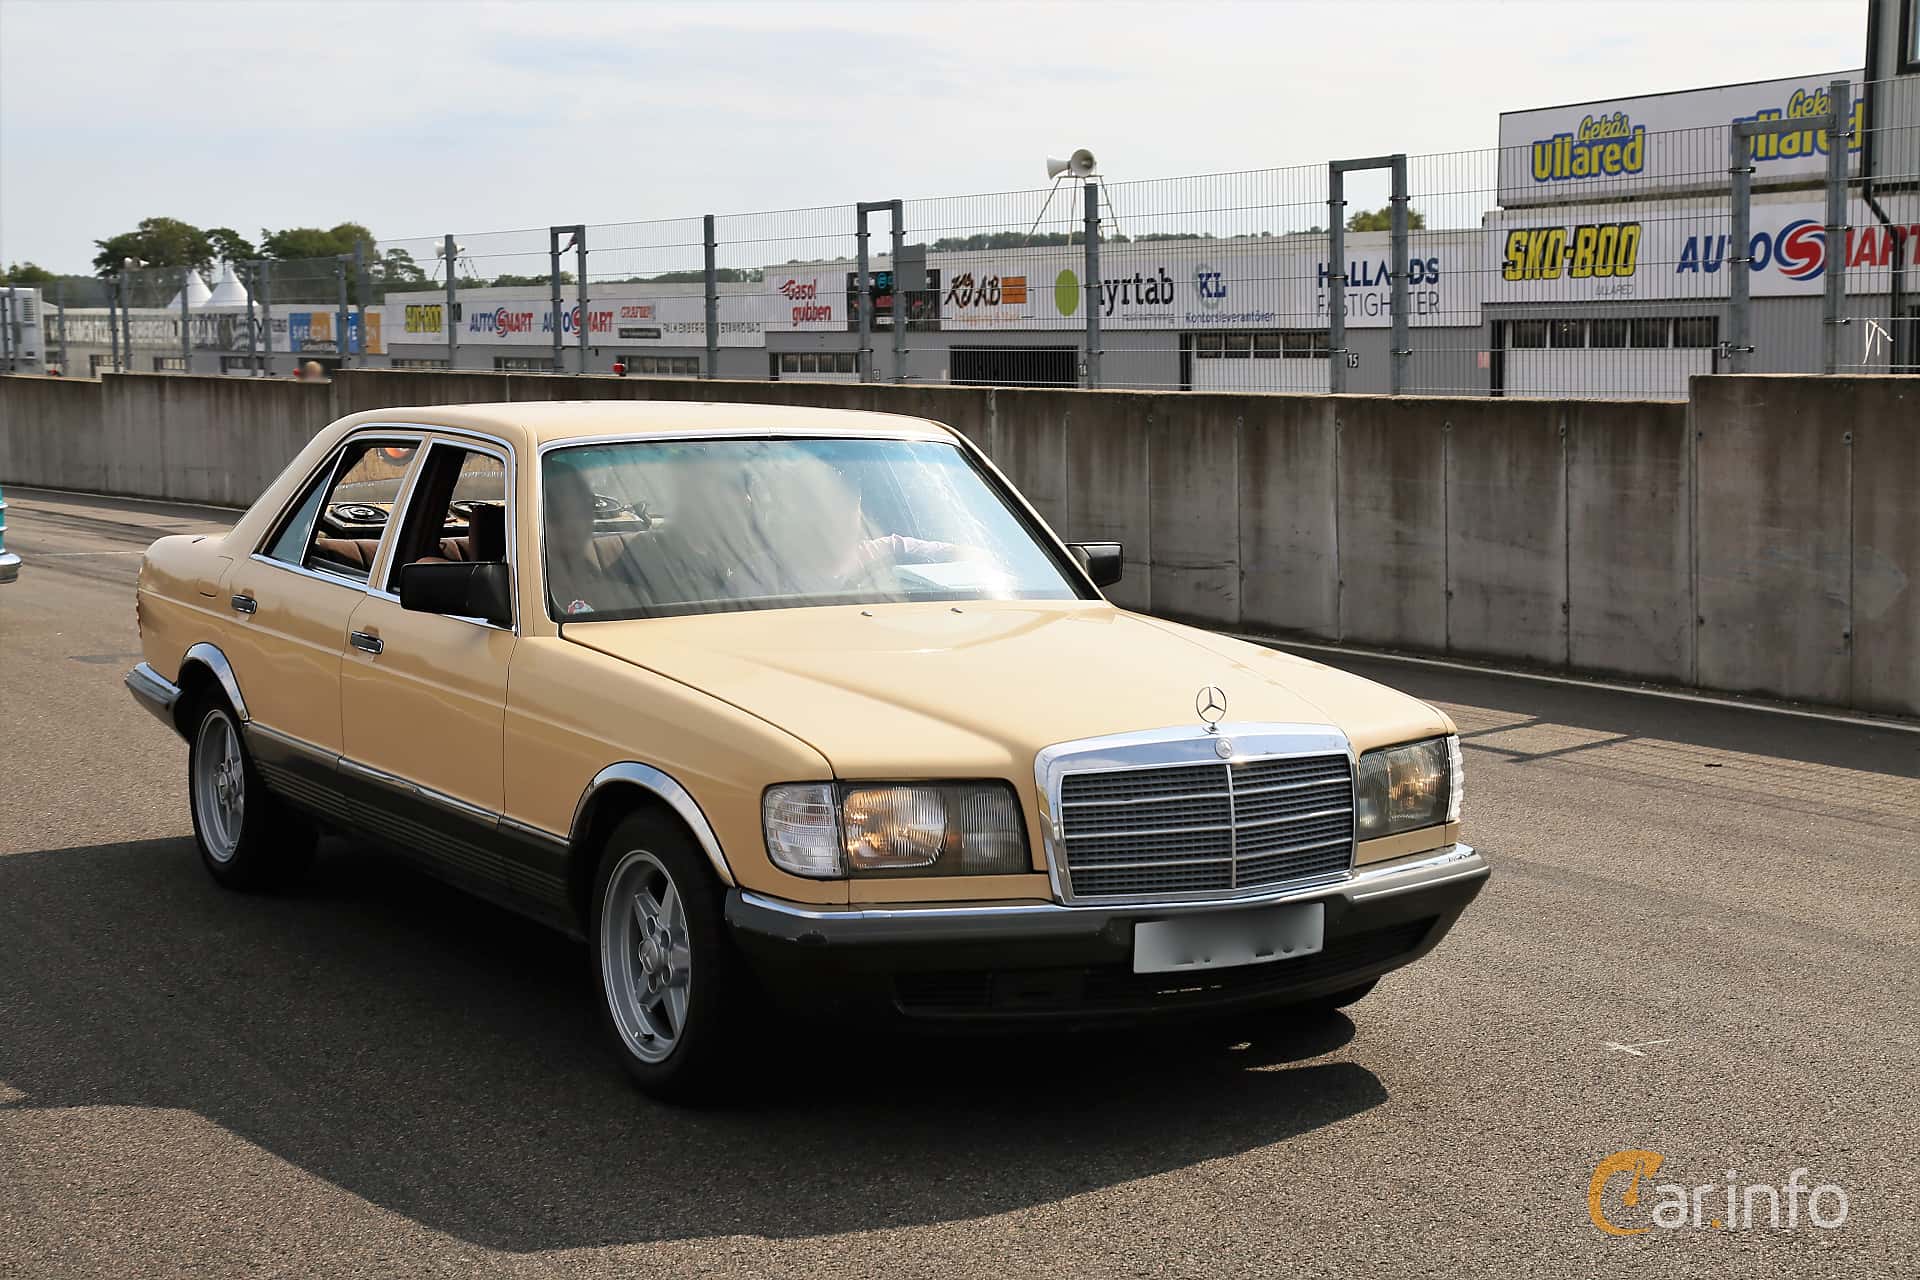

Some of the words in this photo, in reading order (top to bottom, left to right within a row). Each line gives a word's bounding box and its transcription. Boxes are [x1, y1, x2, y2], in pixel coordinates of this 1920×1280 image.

[1787, 88, 1832, 119] Gek
[1577, 111, 1631, 142] Gekås
[1532, 125, 1645, 182] Ullared
[1502, 221, 1641, 281] SKO-BOO
[1318, 257, 1439, 288] HLLADS
[792, 302, 832, 327] gubben
[1318, 291, 1439, 317] FTIGHTER
[1348, 353, 1359, 368] 15
